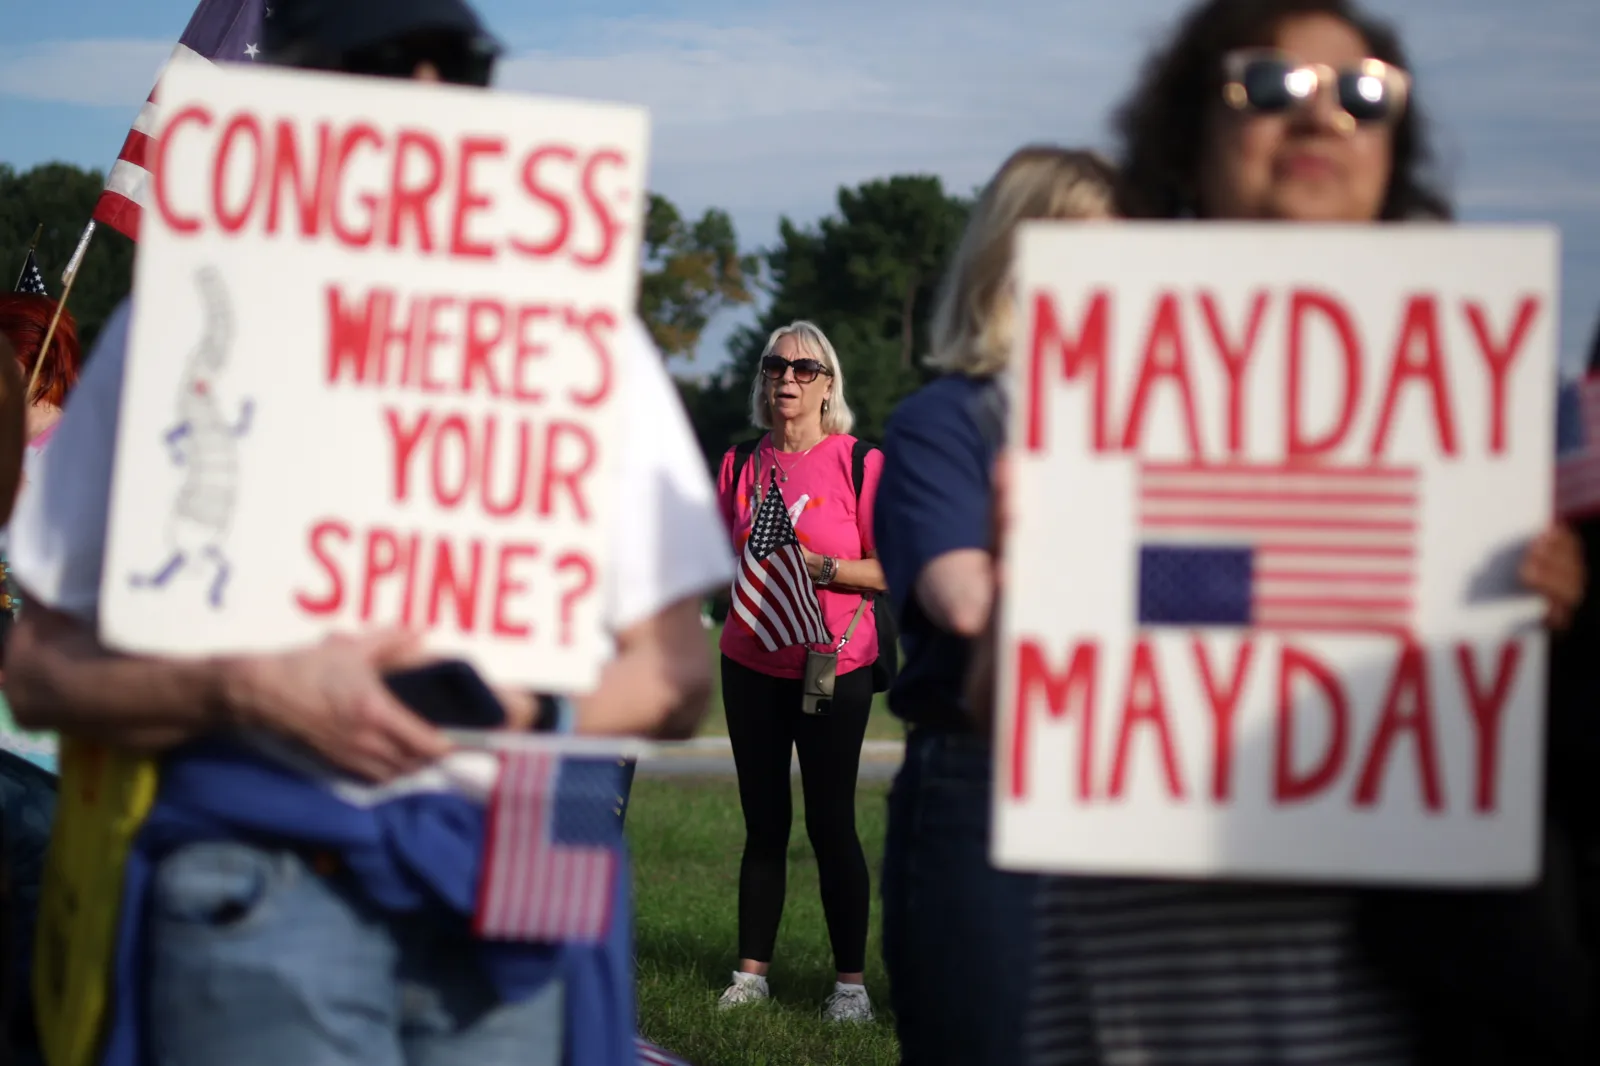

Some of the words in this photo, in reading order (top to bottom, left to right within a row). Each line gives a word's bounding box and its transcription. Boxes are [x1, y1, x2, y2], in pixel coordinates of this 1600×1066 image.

[325, 283, 618, 410] WHERE'S
[1022, 287, 1541, 463] MAYDAY
[383, 407, 596, 522] YOUR
[294, 519, 598, 646] SPINE?
[1006, 634, 1521, 815] MAYDAY
